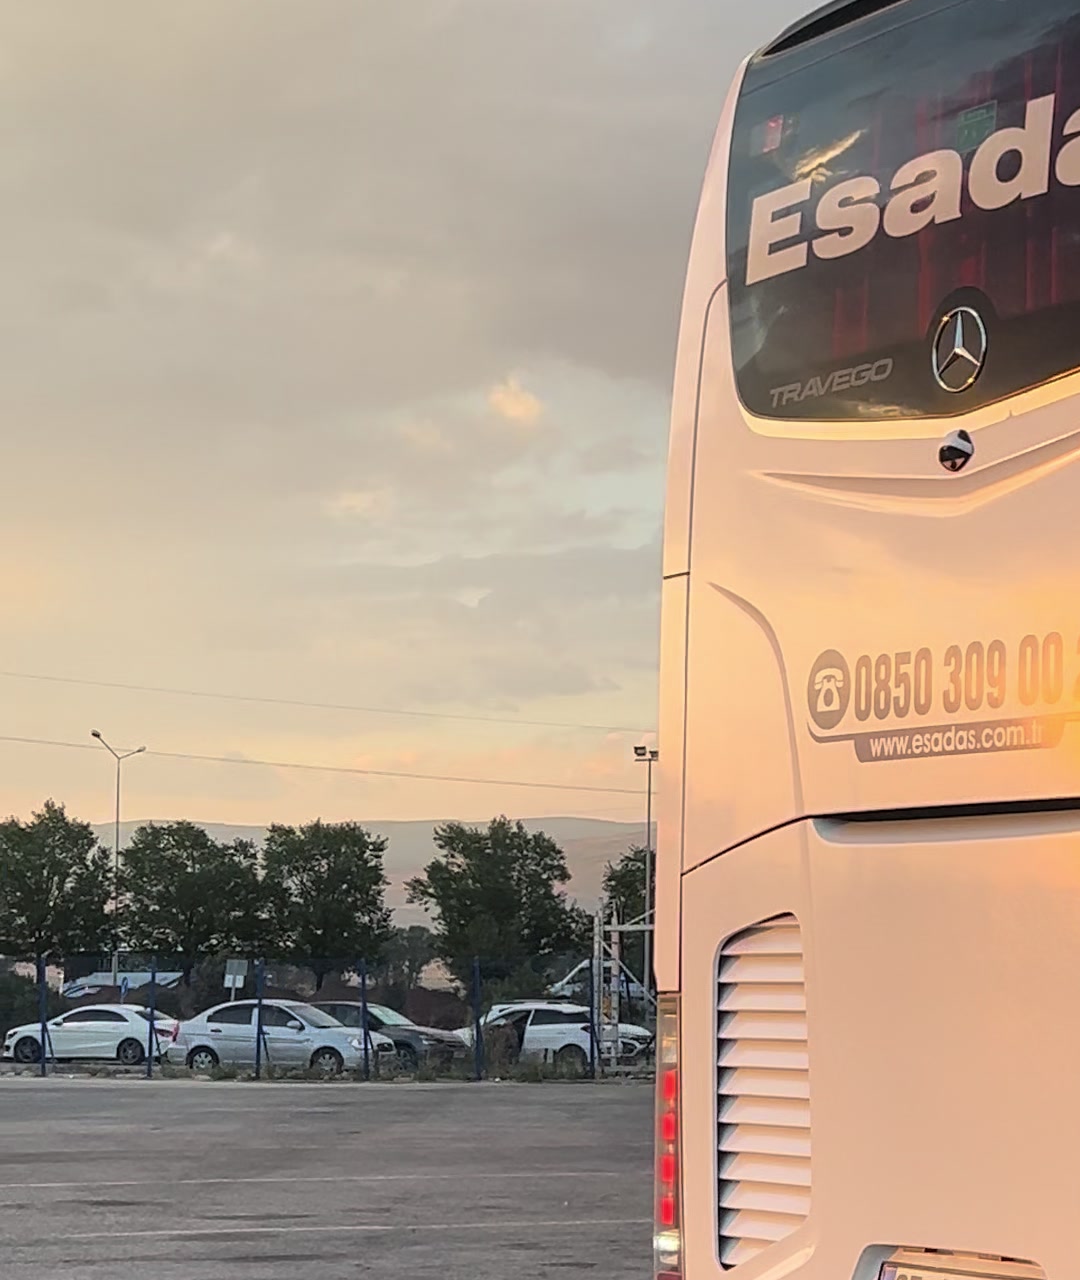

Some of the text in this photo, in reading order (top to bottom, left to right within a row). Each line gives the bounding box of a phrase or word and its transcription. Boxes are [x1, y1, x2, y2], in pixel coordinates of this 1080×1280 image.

[769, 358, 893, 408] TRAVEGO
[854, 647, 933, 721] 0850
[943, 639, 1007, 713] 309
[1018, 631, 1064, 706] 00
